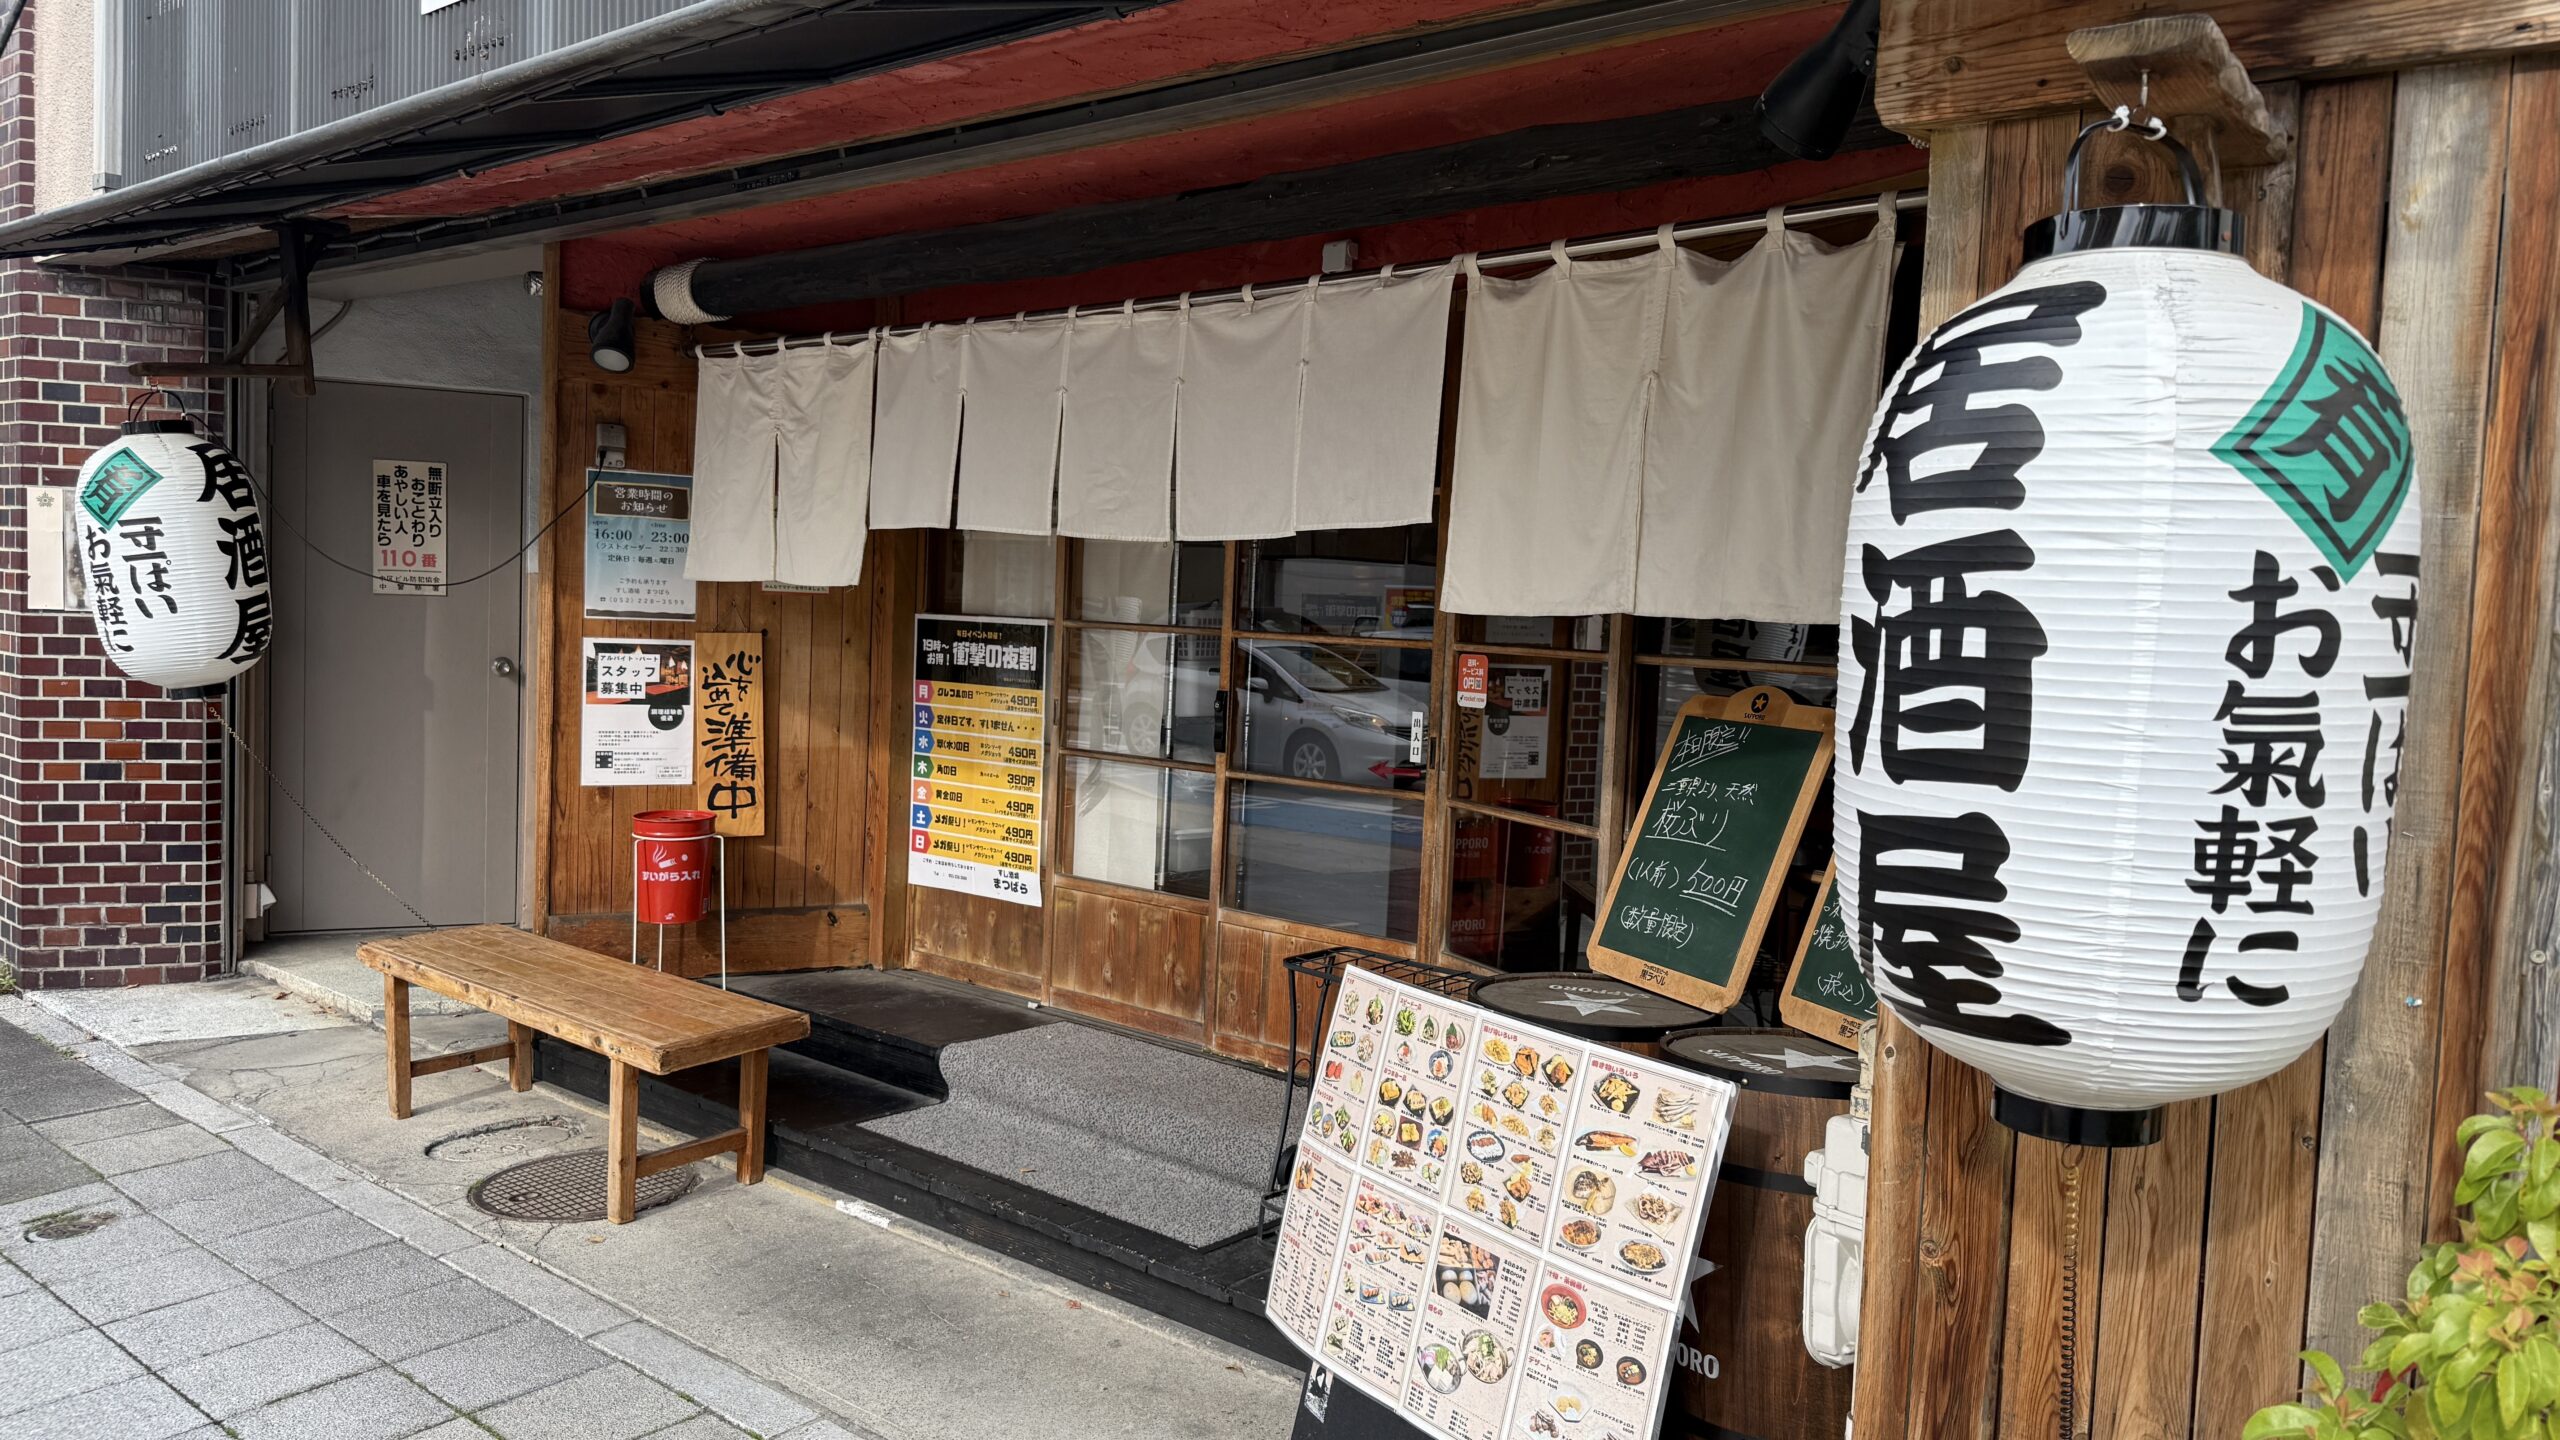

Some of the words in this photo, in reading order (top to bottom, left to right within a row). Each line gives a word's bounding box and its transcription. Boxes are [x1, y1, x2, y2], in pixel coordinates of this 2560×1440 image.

[394, 465, 408, 535] あやしい人
[614, 487, 673, 501] 営業時間の
[377, 475, 391, 546] 車を見たら
[428, 467, 442, 538] 無断立入り
[621, 501, 668, 513] お知らせ
[411, 478, 425, 547] おことわり
[594, 529, 632, 540] 16:00
[651, 532, 689, 544] 23:00
[185, 443, 273, 664] 居酒屋
[381, 549, 437, 568] 110番
[118, 516, 178, 618] 一寸一ぱい
[953, 641, 1037, 671] 衝撃の夜割
[1849, 281, 2107, 1046] 居酒屋
[602, 665, 656, 677] スタッフ
[600, 682, 643, 695] 募集中
[919, 685, 928, 699] 月
[1010, 695, 1038, 707] 490円
[919, 711, 928, 725] 火
[919, 736, 928, 749] 水
[1412, 717, 1421, 757] 出入口
[1008, 746, 1036, 759] 490円
[702, 711, 757, 819] 準備中
[917, 760, 928, 775] 木
[1007, 773, 1035, 787] 390円
[917, 786, 927, 799] 金
[1006, 800, 1034, 814] 490円
[916, 810, 926, 824] 土
[1005, 826, 1033, 840] 490円
[1004, 852, 1032, 865] 490円
[642, 870, 700, 882] すいがら入れ
[993, 878, 1028, 894] まつばら
[1640, 969, 1666, 986] 黒ラベル
